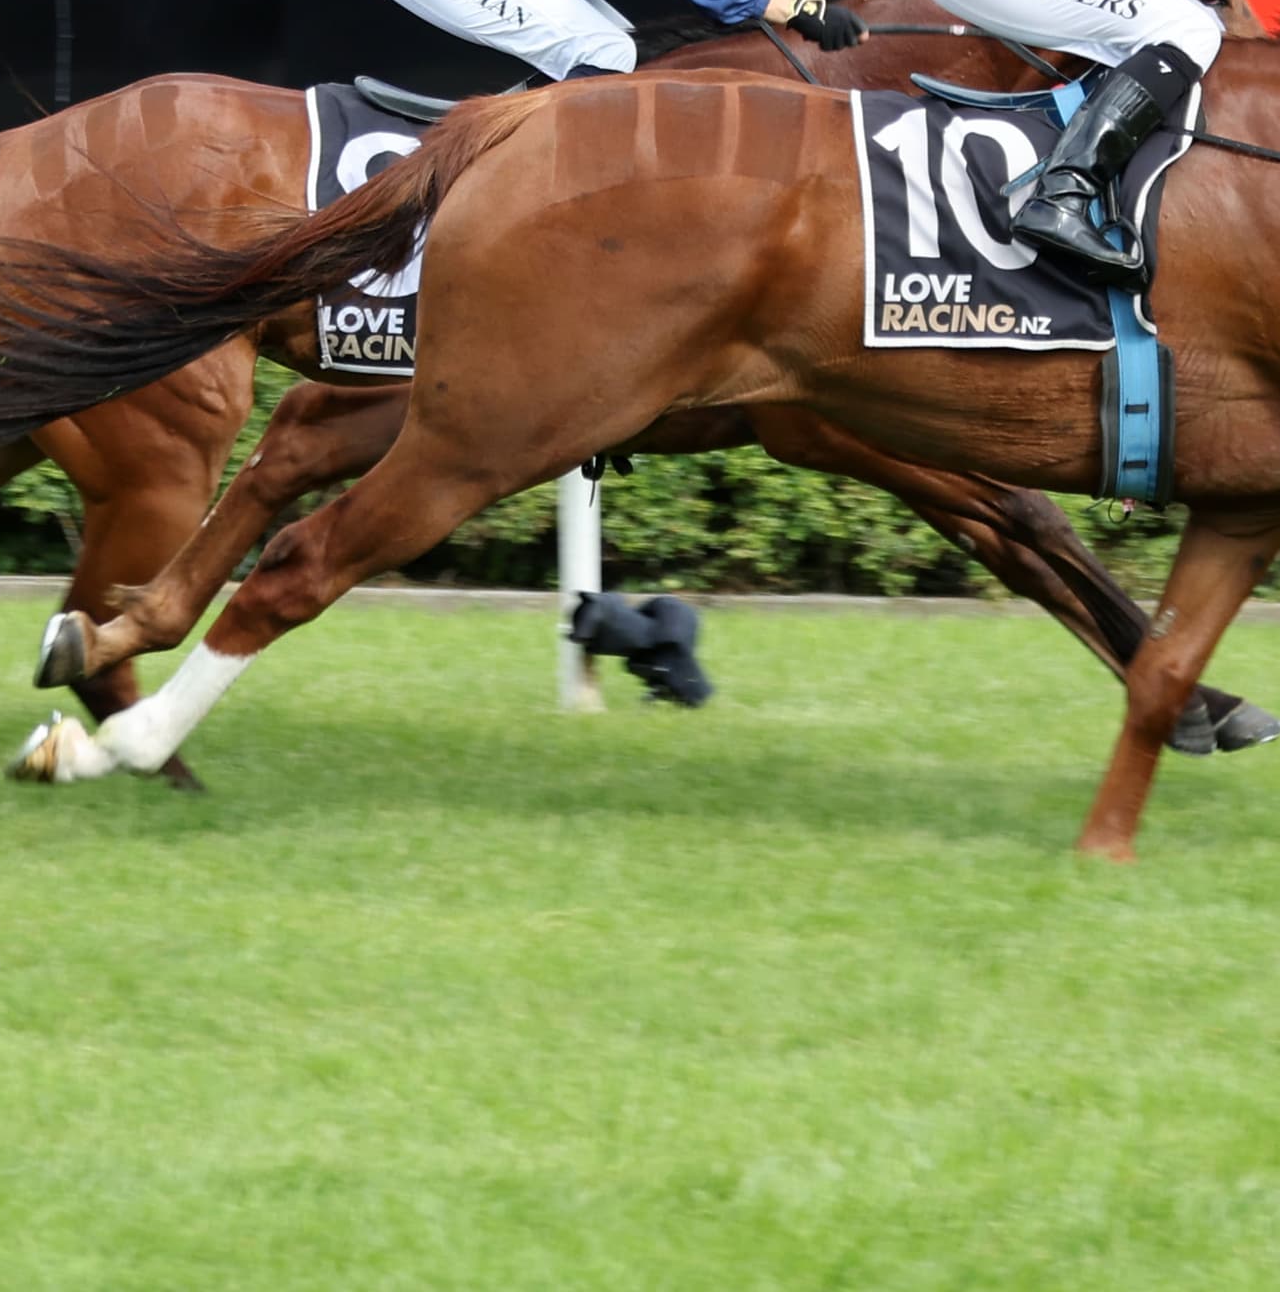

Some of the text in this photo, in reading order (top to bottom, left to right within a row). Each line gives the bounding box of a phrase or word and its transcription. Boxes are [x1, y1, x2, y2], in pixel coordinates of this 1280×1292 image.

[872, 108, 1039, 270] 10
[884, 273, 973, 303] LOVE
[323, 305, 406, 335] LOVE
[880, 304, 1052, 336] RACING.NZ
